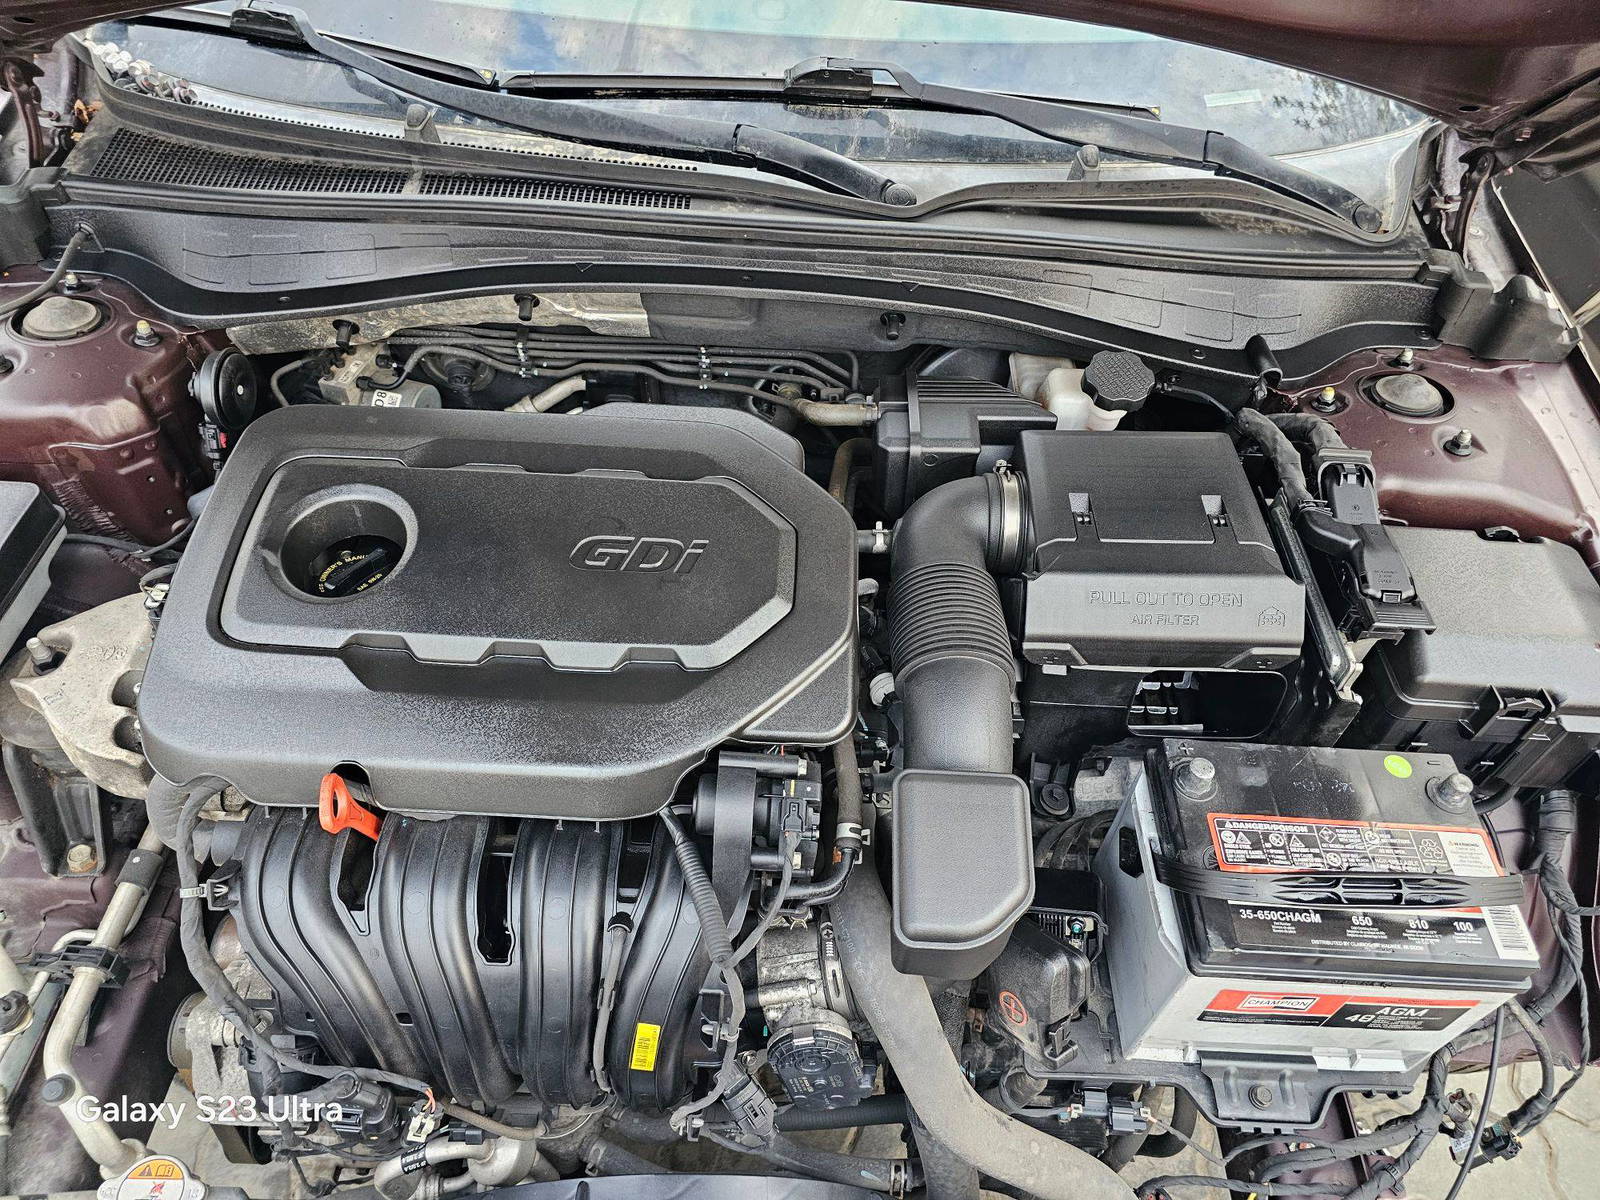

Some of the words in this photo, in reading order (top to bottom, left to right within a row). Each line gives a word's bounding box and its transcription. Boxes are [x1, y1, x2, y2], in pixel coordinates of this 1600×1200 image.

[568, 535, 709, 574] GDi
[1089, 590, 1131, 605] PULL
[1135, 591, 1168, 606] OUT
[1174, 592, 1195, 607] TO
[1199, 592, 1243, 607] OPEN
[1131, 614, 1153, 625] AIR
[1156, 614, 1200, 626] FILTER
[1239, 908, 1322, 924] 35-650CHAGM
[1351, 915, 1373, 927] 650
[1408, 918, 1429, 930] 810
[1452, 921, 1474, 932] 100
[1247, 998, 1308, 1008] CHAMPION
[1375, 1006, 1430, 1017] AGM
[1344, 1014, 1376, 1023] 48
